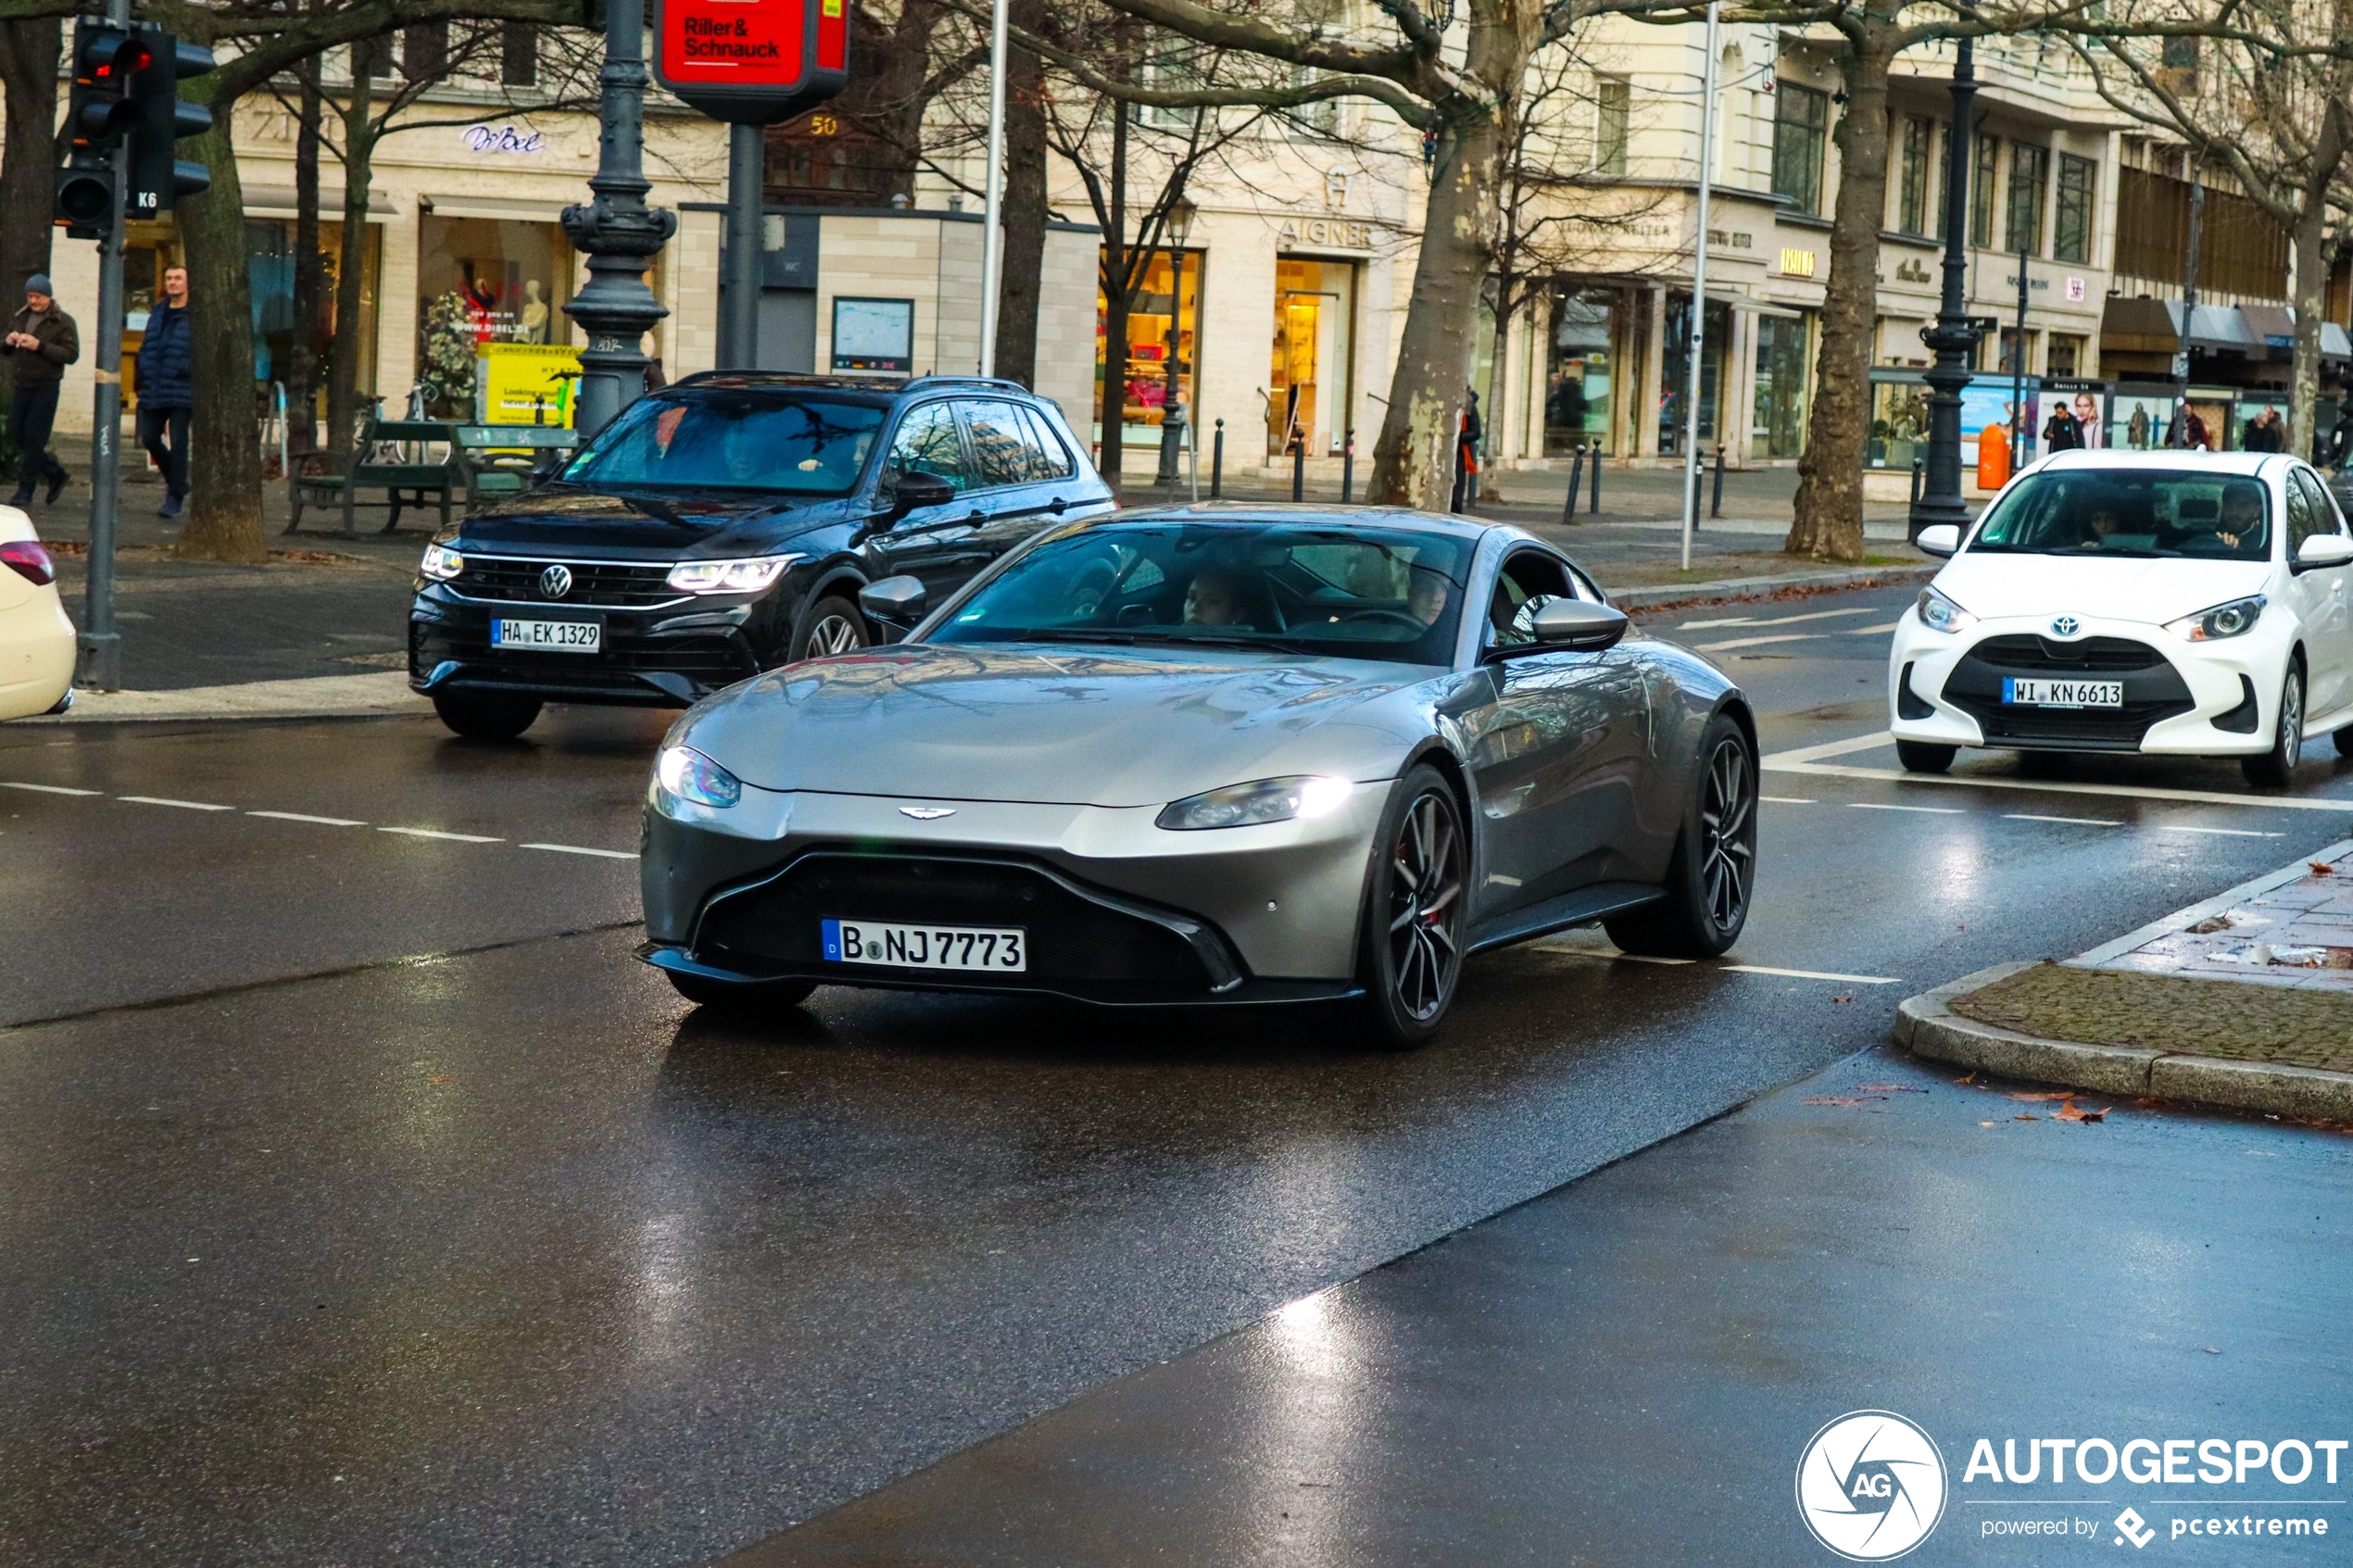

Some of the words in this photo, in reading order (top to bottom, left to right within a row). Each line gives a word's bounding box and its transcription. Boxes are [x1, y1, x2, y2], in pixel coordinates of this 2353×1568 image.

[684, 18, 733, 37] Riller
[735, 19, 749, 37] &
[684, 38, 780, 58] Schnauck
[811, 117, 837, 135] 50
[138, 192, 157, 208] K6
[1280, 219, 1372, 248] AIGNER
[785, 261, 799, 272] WC
[504, 388, 536, 397] Looking
[502, 622, 522, 641] HA
[534, 623, 554, 643] EK
[558, 625, 598, 645] 1329
[2016, 683, 2035, 700] WI
[2051, 684, 2073, 702] KN
[2077, 684, 2120, 704] 6613
[843, 926, 862, 959] B
[886, 929, 928, 963] NJ
[935, 932, 1020, 967] 7773
